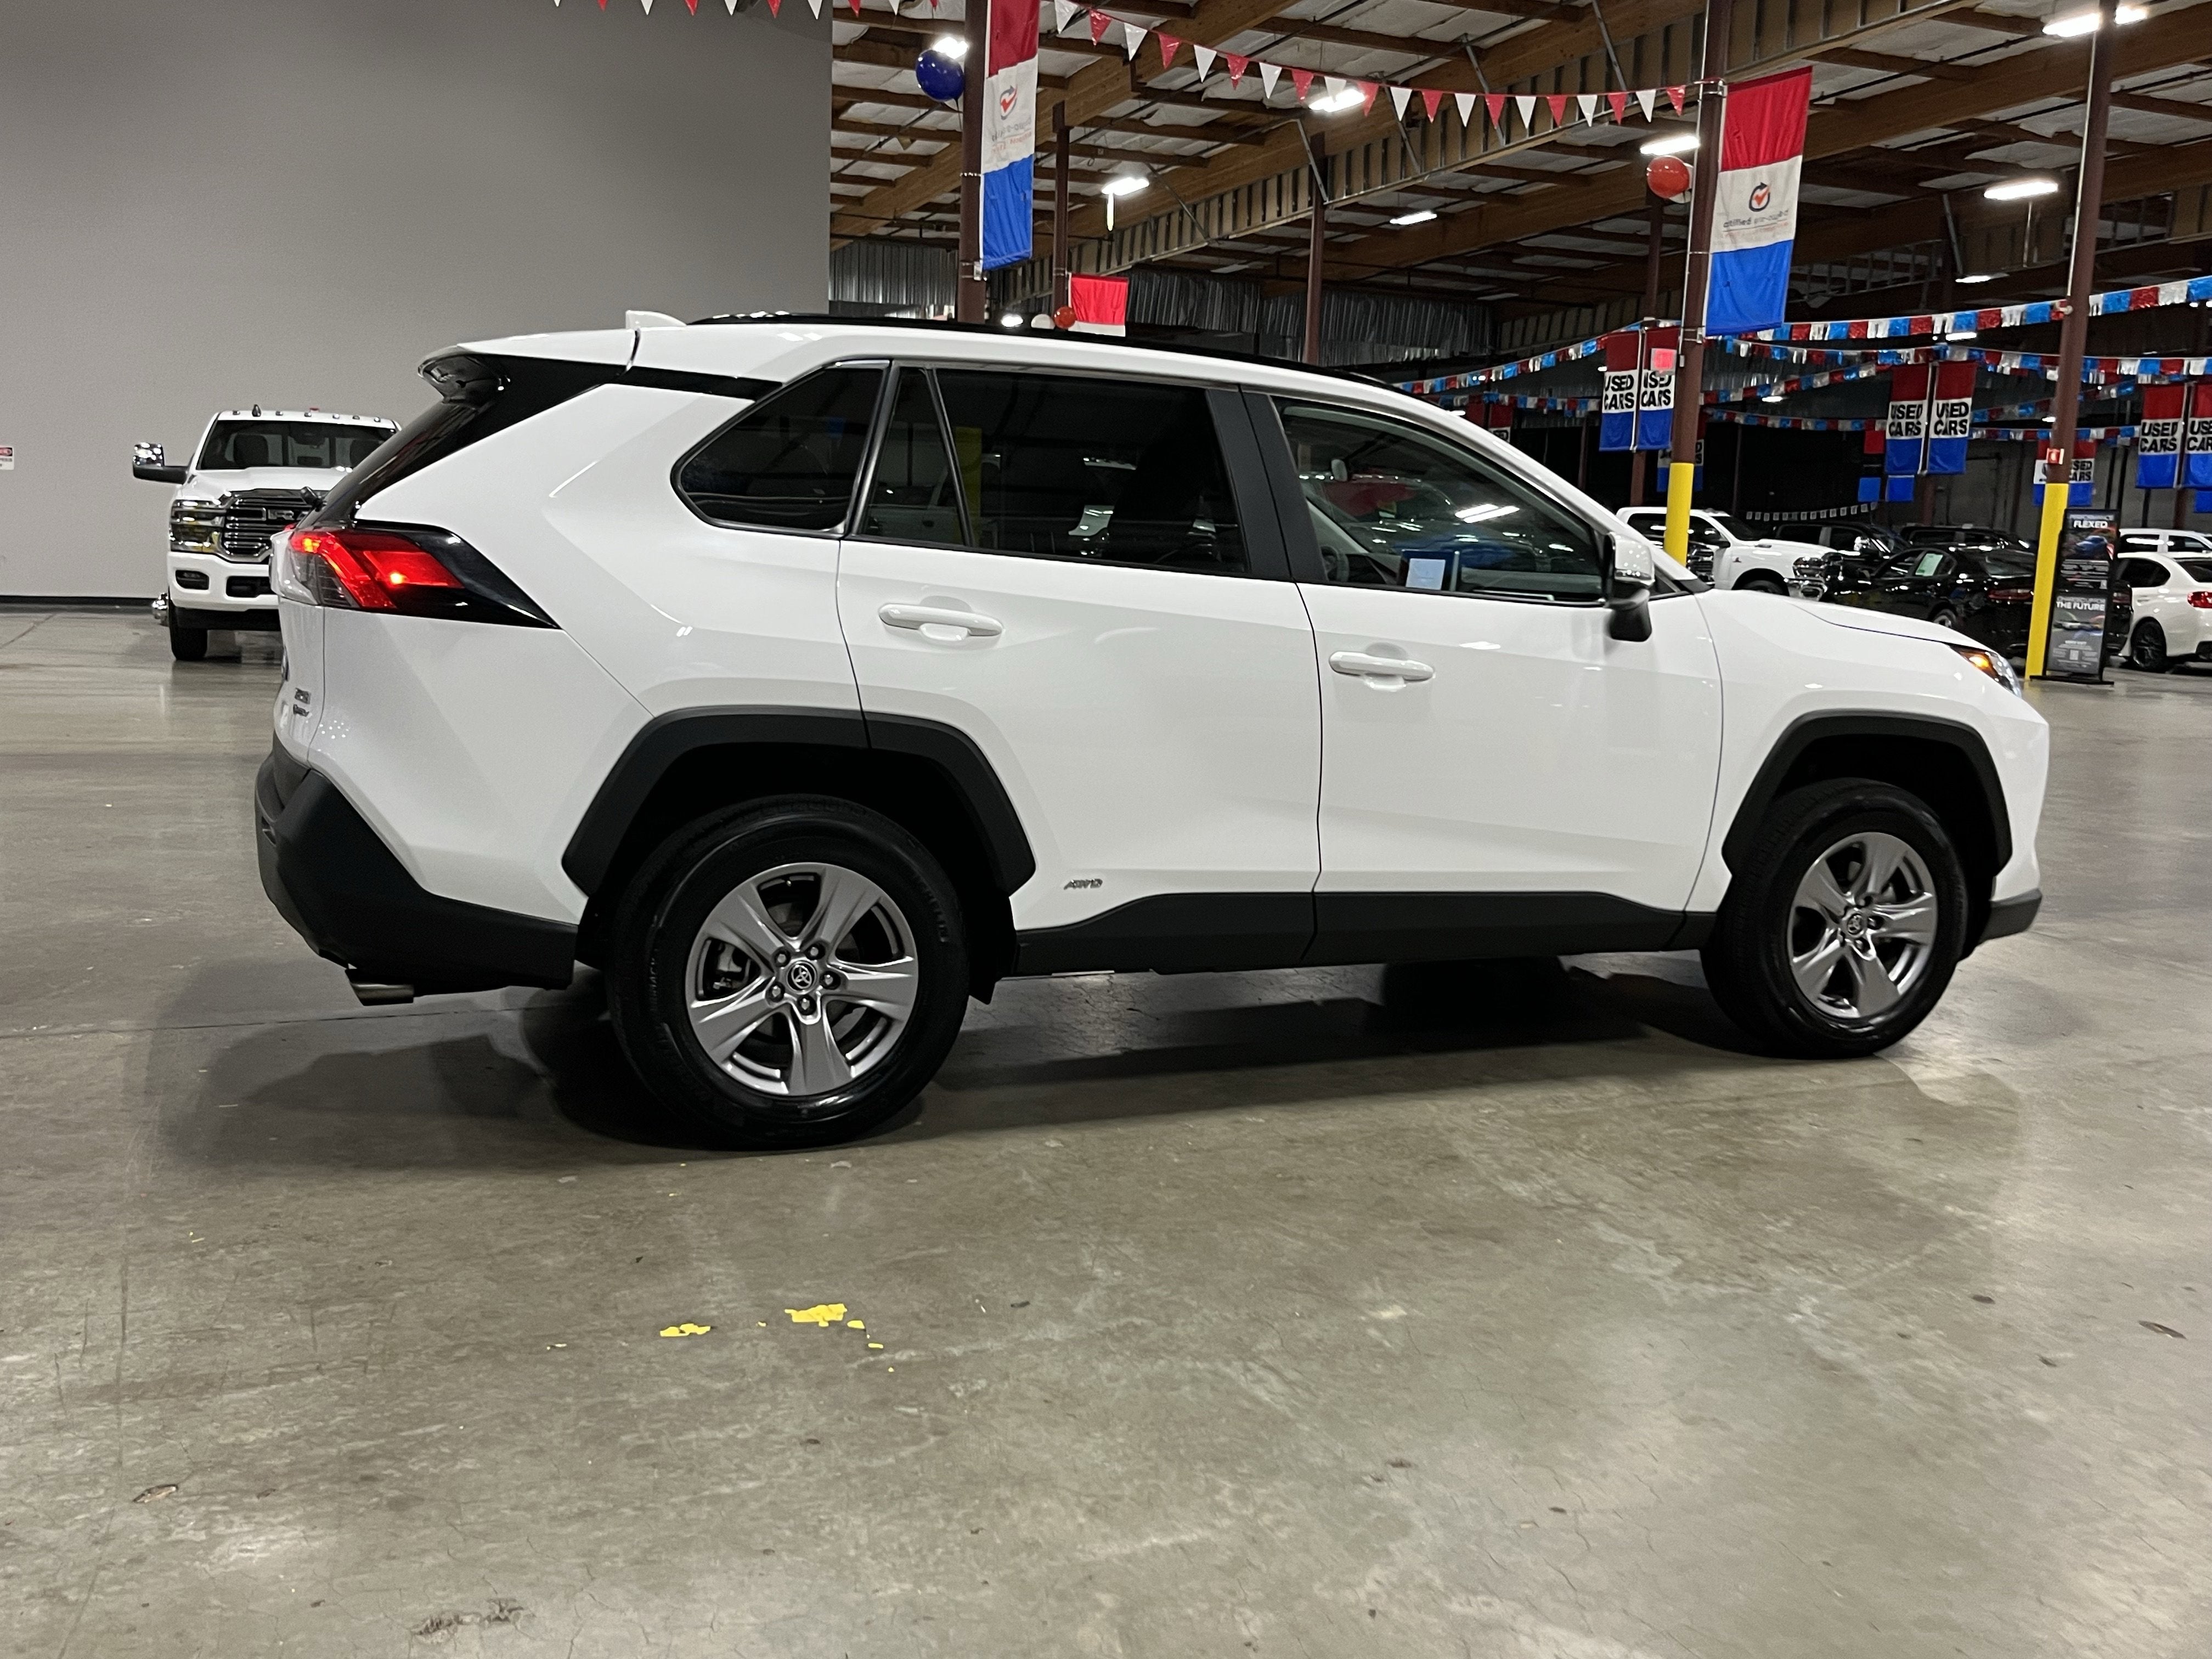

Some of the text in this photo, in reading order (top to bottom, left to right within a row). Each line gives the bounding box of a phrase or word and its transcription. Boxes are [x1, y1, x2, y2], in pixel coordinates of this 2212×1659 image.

[1891, 404, 1923, 420] USED
[1936, 402, 1970, 418] USED
[1889, 420, 1921, 437] CARS
[1934, 419, 1968, 436] CARS
[2142, 422, 2179, 437] USED
[2140, 437, 2177, 453] CARS
[2072, 460, 2092, 471] SED
[2071, 471, 2091, 481] ARS
[2074, 520, 2108, 529] FLEXED
[2056, 601, 2106, 612] THE FUTURE
